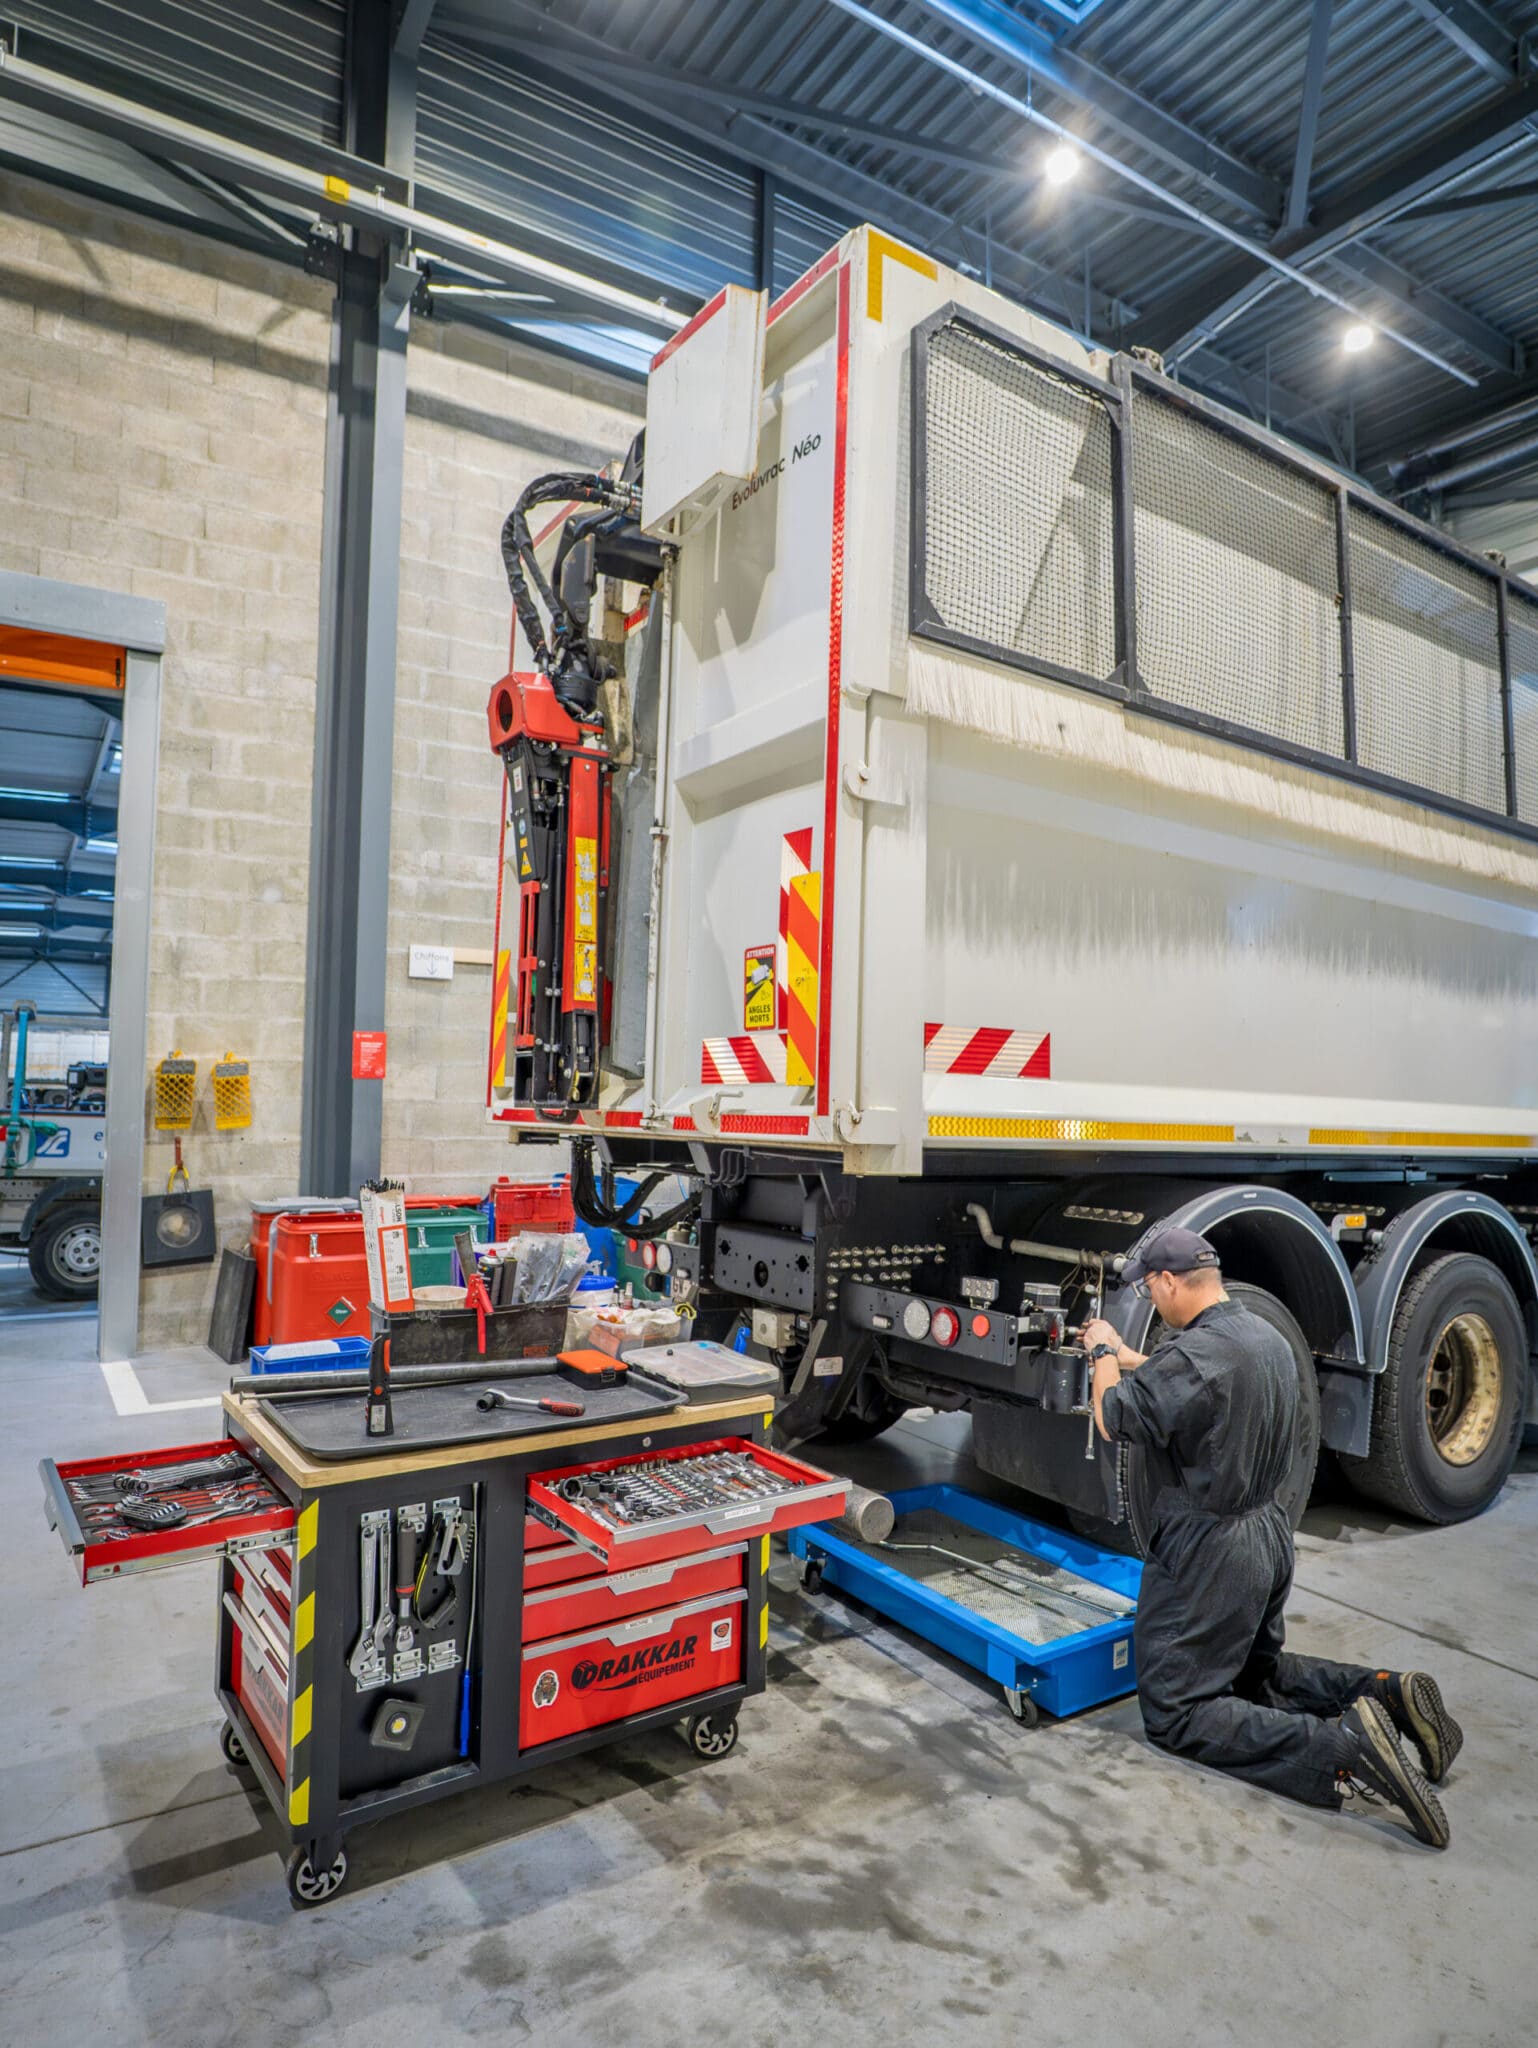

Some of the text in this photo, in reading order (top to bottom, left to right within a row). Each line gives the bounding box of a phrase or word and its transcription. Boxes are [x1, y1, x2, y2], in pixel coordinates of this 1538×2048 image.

[792, 434, 822, 464] Néo
[748, 1005, 771, 1015] ANGLES
[749, 1014, 770, 1023] MORTS
[575, 1635, 698, 1688] DRAKKAR
